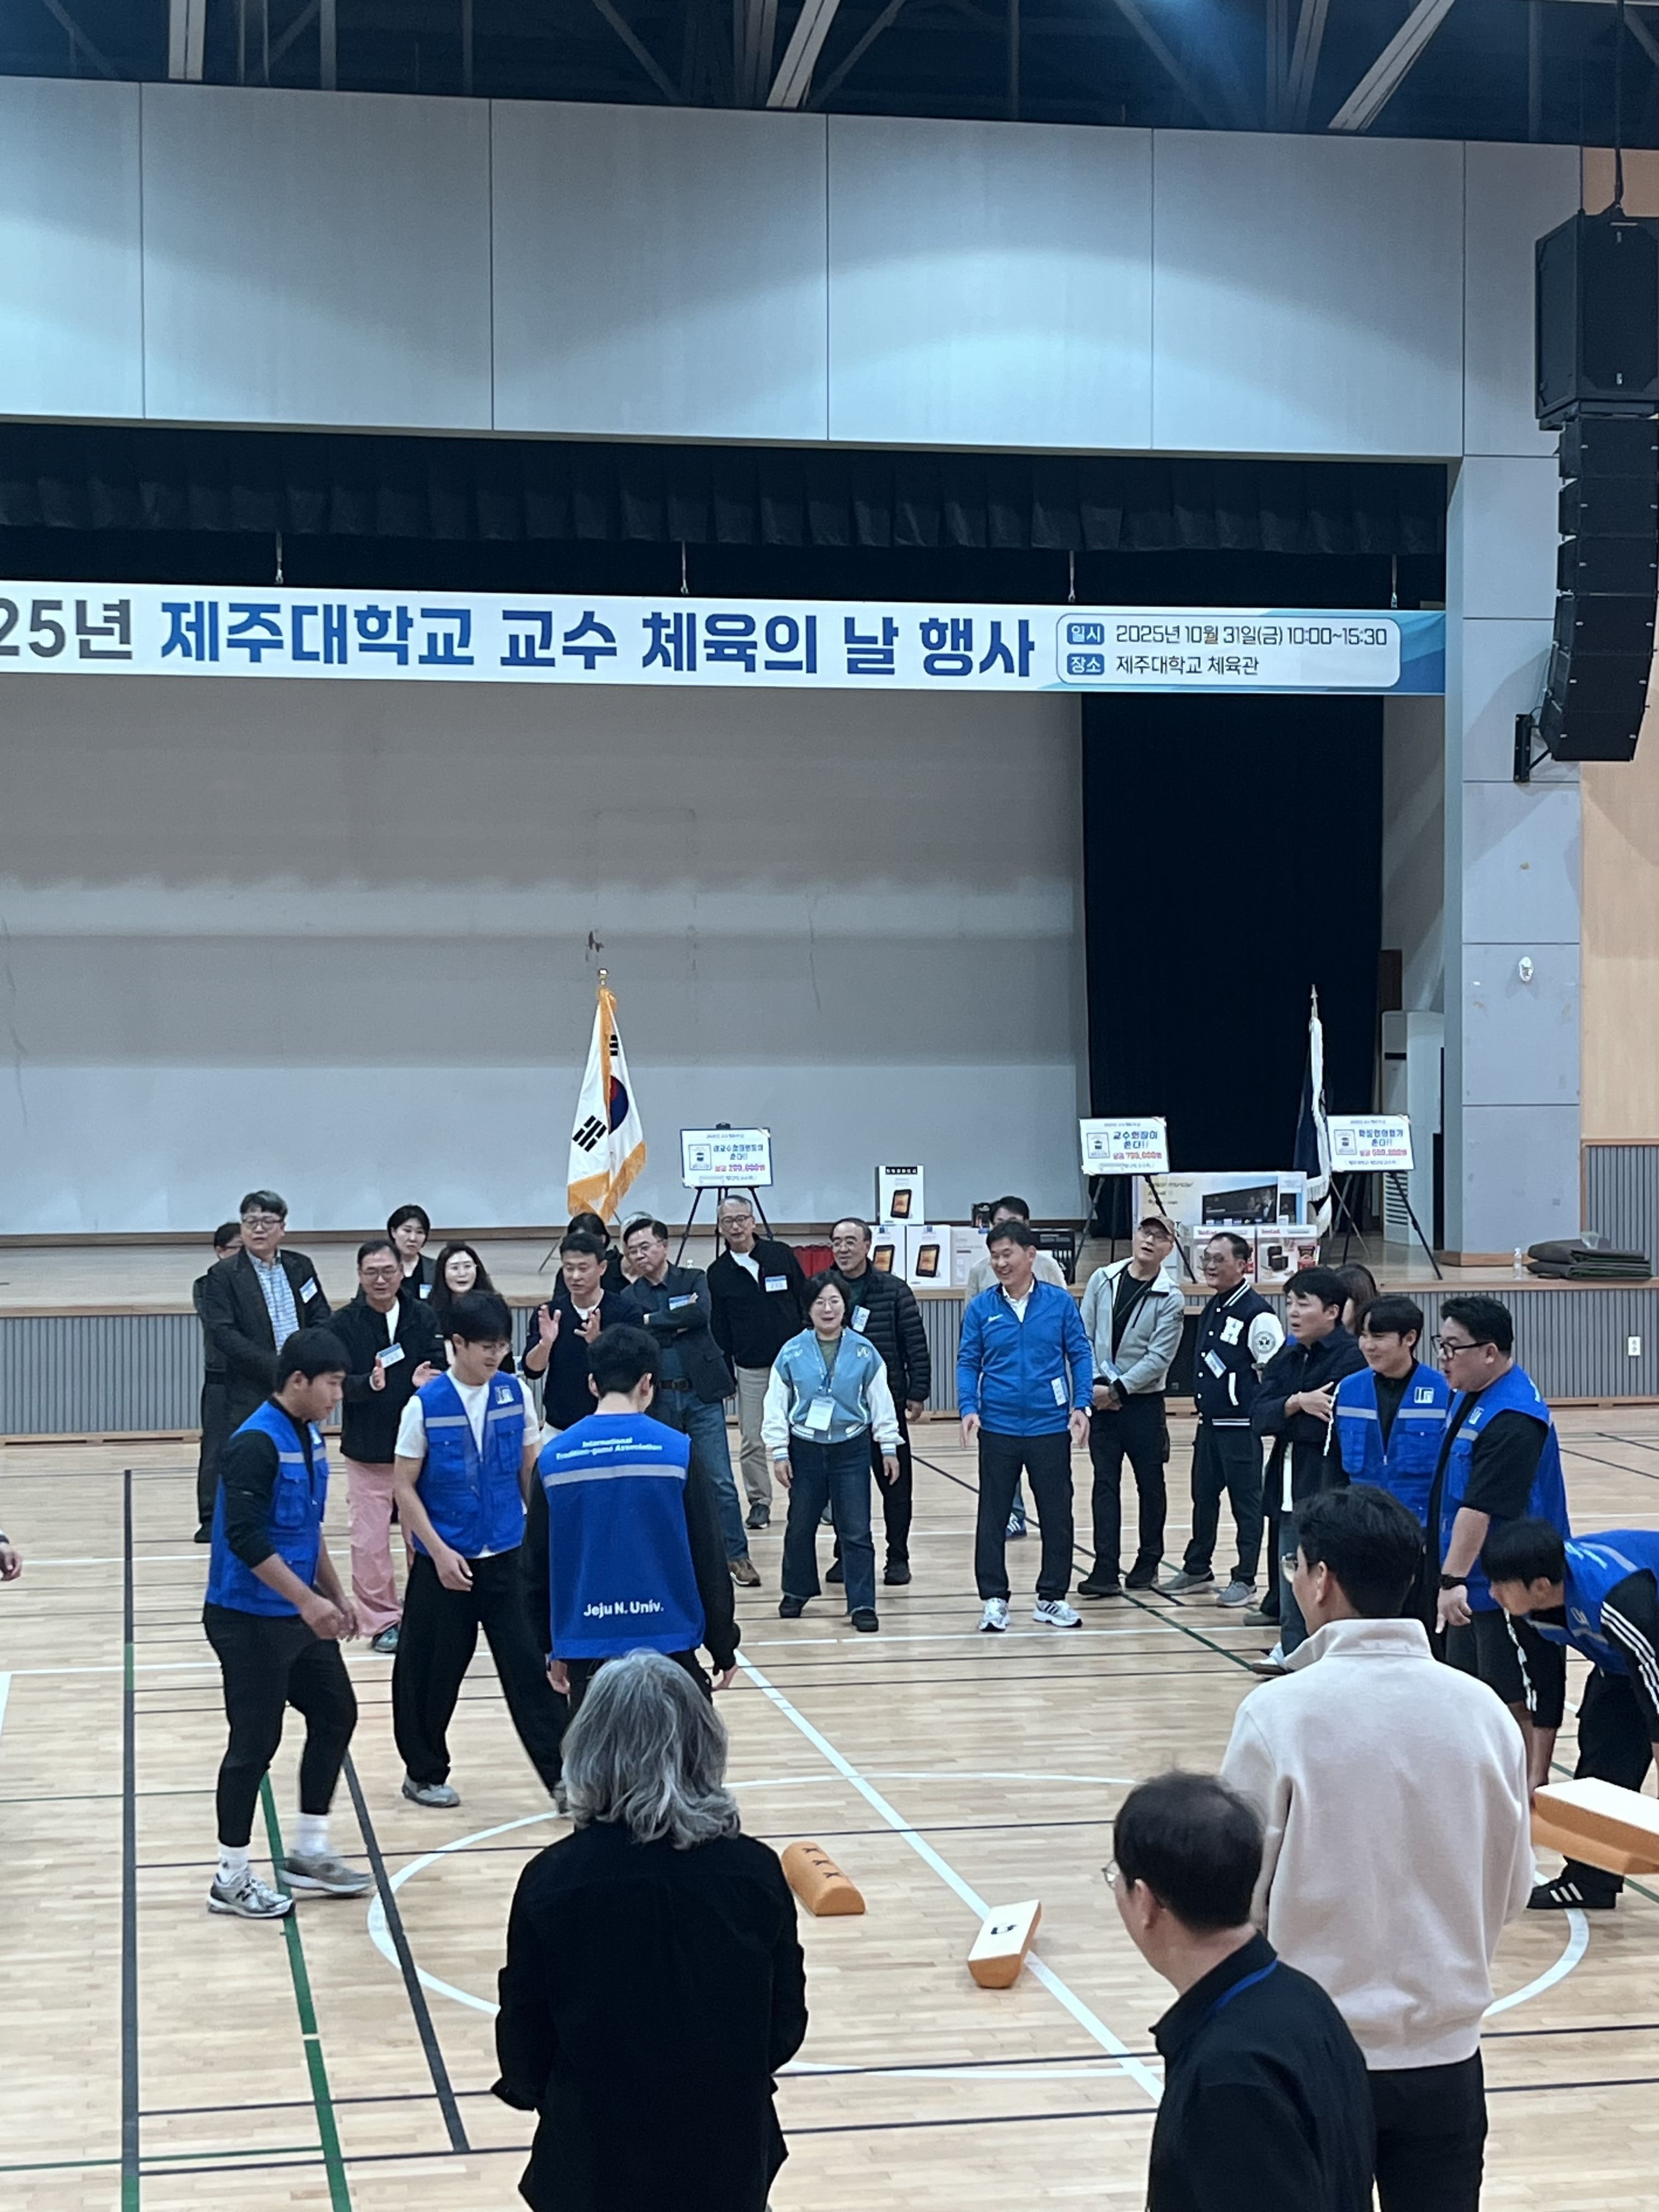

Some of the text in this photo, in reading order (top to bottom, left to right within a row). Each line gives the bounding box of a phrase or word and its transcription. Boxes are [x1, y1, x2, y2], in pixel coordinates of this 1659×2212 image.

[161, 600, 475, 665] 제주대학교
[500, 610, 618, 670] 교수
[642, 611, 817, 674] 체육의
[844, 616, 899, 675] 날
[919, 617, 1035, 677] 행사
[1071, 624, 1387, 646] 일시 2025년 10월 31일(금) 10:00~15:30
[1071, 655, 1260, 676] 장소 제주대학교 체육관
[582, 1436, 633, 1448] International
[583, 1599, 664, 1619] Jeju N. Univ.
